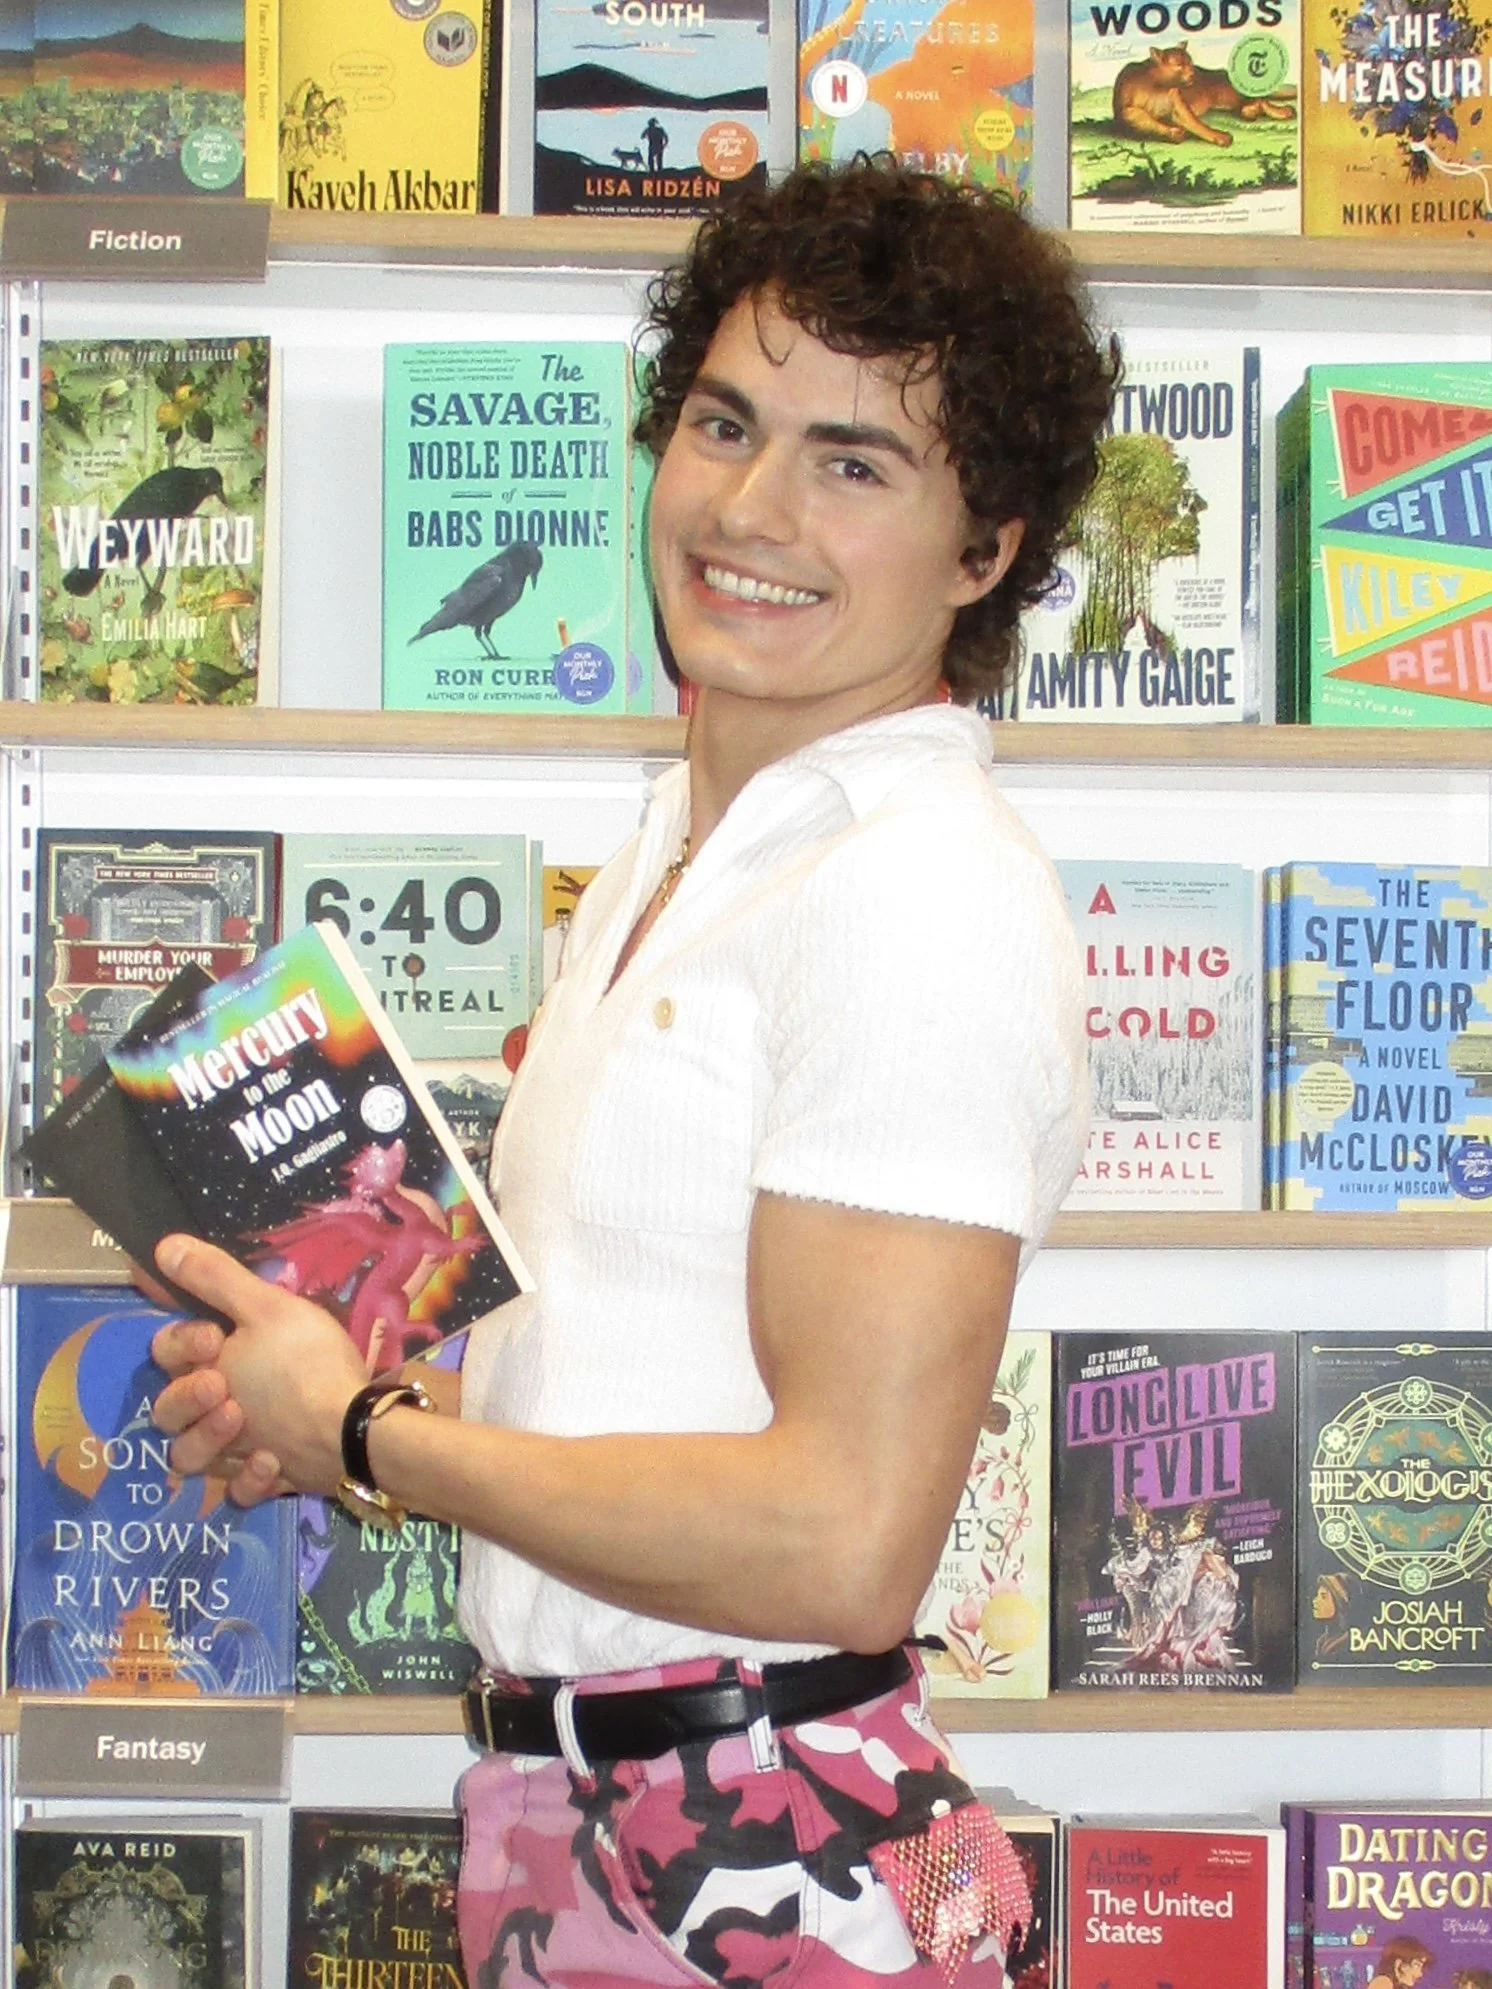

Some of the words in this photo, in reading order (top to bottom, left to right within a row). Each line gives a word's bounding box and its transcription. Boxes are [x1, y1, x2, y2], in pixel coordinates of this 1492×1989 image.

[605, 0, 704, 28] SOUTH
[1091, 0, 1284, 36] WOODS
[840, 20, 1000, 44] CREATURES
[1388, 14, 1442, 49] THE
[832, 75, 847, 103] N
[1320, 57, 1492, 104] MEASUR
[904, 90, 941, 101] NOVEL
[903, 151, 969, 176] ELBY
[287, 170, 377, 212] Kaveh
[383, 169, 476, 211] Akbar
[586, 178, 632, 197] LISA
[642, 176, 720, 198] RIDZÉN
[1343, 202, 1401, 226] NIKKI
[1412, 200, 1484, 224] ERLICK
[89, 229, 183, 251] Fiction
[540, 354, 584, 383] The
[410, 391, 612, 431] SAVAGE,
[1109, 382, 1233, 441] TWOOD
[1343, 403, 1466, 476] COME
[408, 441, 500, 480] NOBLE
[510, 439, 609, 479] DEATH
[501, 488, 516, 504] of
[1367, 479, 1447, 535] GET
[53, 505, 255, 571] WEYWARD
[408, 510, 482, 548] BABS
[494, 509, 610, 548] DIONNE
[115, 575, 140, 589] Novel
[1339, 561, 1463, 636] KILEY
[102, 613, 160, 642] EMILIA
[165, 614, 208, 640] HART
[1385, 620, 1492, 694] REID
[435, 669, 483, 686] RON
[491, 668, 557, 686] CURR
[1026, 650, 1131, 710] AMITY
[1139, 647, 1236, 708] GAIGE
[427, 692, 465, 702] AUTHOR
[483, 690, 543, 702] EVERYTHING
[1088, 882, 1117, 915] A
[1378, 879, 1431, 909] THE
[305, 876, 502, 946] 6:40
[98, 949, 163, 967] MURDER
[170, 950, 213, 967] YOUR
[381, 952, 426, 978] TO
[1086, 944, 1231, 978] LLING
[115, 966, 181, 983] EMPLOY
[1336, 980, 1473, 1032] FLOOR
[1086, 1006, 1216, 1039] COLD
[166, 987, 329, 1111] Mercury
[1358, 1048, 1370, 1069] A
[1378, 1047, 1442, 1070] NOVEL
[243, 1084, 264, 1107] to
[261, 1067, 292, 1096] the
[1352, 1084, 1452, 1125] DAVID
[230, 1078, 342, 1164] Moon
[1134, 1131, 1222, 1150] ALICE
[1299, 1131, 1490, 1175] McCLOSK
[1076, 1160, 1214, 1180] ARSHALL
[1338, 1182, 1375, 1194] AUTHOR
[1394, 1179, 1450, 1196] MOSCOW
[1080, 1364, 1105, 1380] YOUR
[1105, 1359, 1140, 1376] VILLAIN
[1087, 1351, 1106, 1367] IT'S
[1107, 1348, 1130, 1364] TIME
[1131, 1345, 1150, 1361] FOR
[136, 1396, 152, 1419] A
[1071, 1377, 1167, 1442] LONG
[1183, 1358, 1269, 1423] LIVE
[78, 1437, 172, 1473] SON
[1122, 1425, 1236, 1505] EVIL
[1401, 1458, 1431, 1469] THE
[127, 1481, 162, 1505] TO
[53, 1519, 231, 1564] DROWN
[54, 1574, 231, 1621] RIVERS
[1372, 1600, 1462, 1626] JOSIAH
[70, 1632, 123, 1652] ANN
[138, 1632, 213, 1652] LIANG
[1350, 1626, 1485, 1652] BANCROFT
[397, 1654, 441, 1665] JOHN
[382, 1669, 456, 1680] WISWELL
[1078, 1671, 1135, 1687] SARAH
[1138, 1672, 1180, 1687] REES
[1183, 1672, 1264, 1688] BRENNAN
[97, 1735, 207, 1765] Fantasy
[73, 1841, 114, 1857] AVA
[124, 1842, 176, 1858] REID
[1339, 1822, 1488, 1863] DATING
[1107, 1848, 1152, 1866] Little
[1086, 1867, 1154, 1888] History
[1159, 1867, 1181, 1886] of
[1085, 1889, 1137, 1916] The
[1143, 1890, 1233, 1918] United
[391, 1926, 432, 1952] THE
[1085, 1917, 1163, 1945] States
